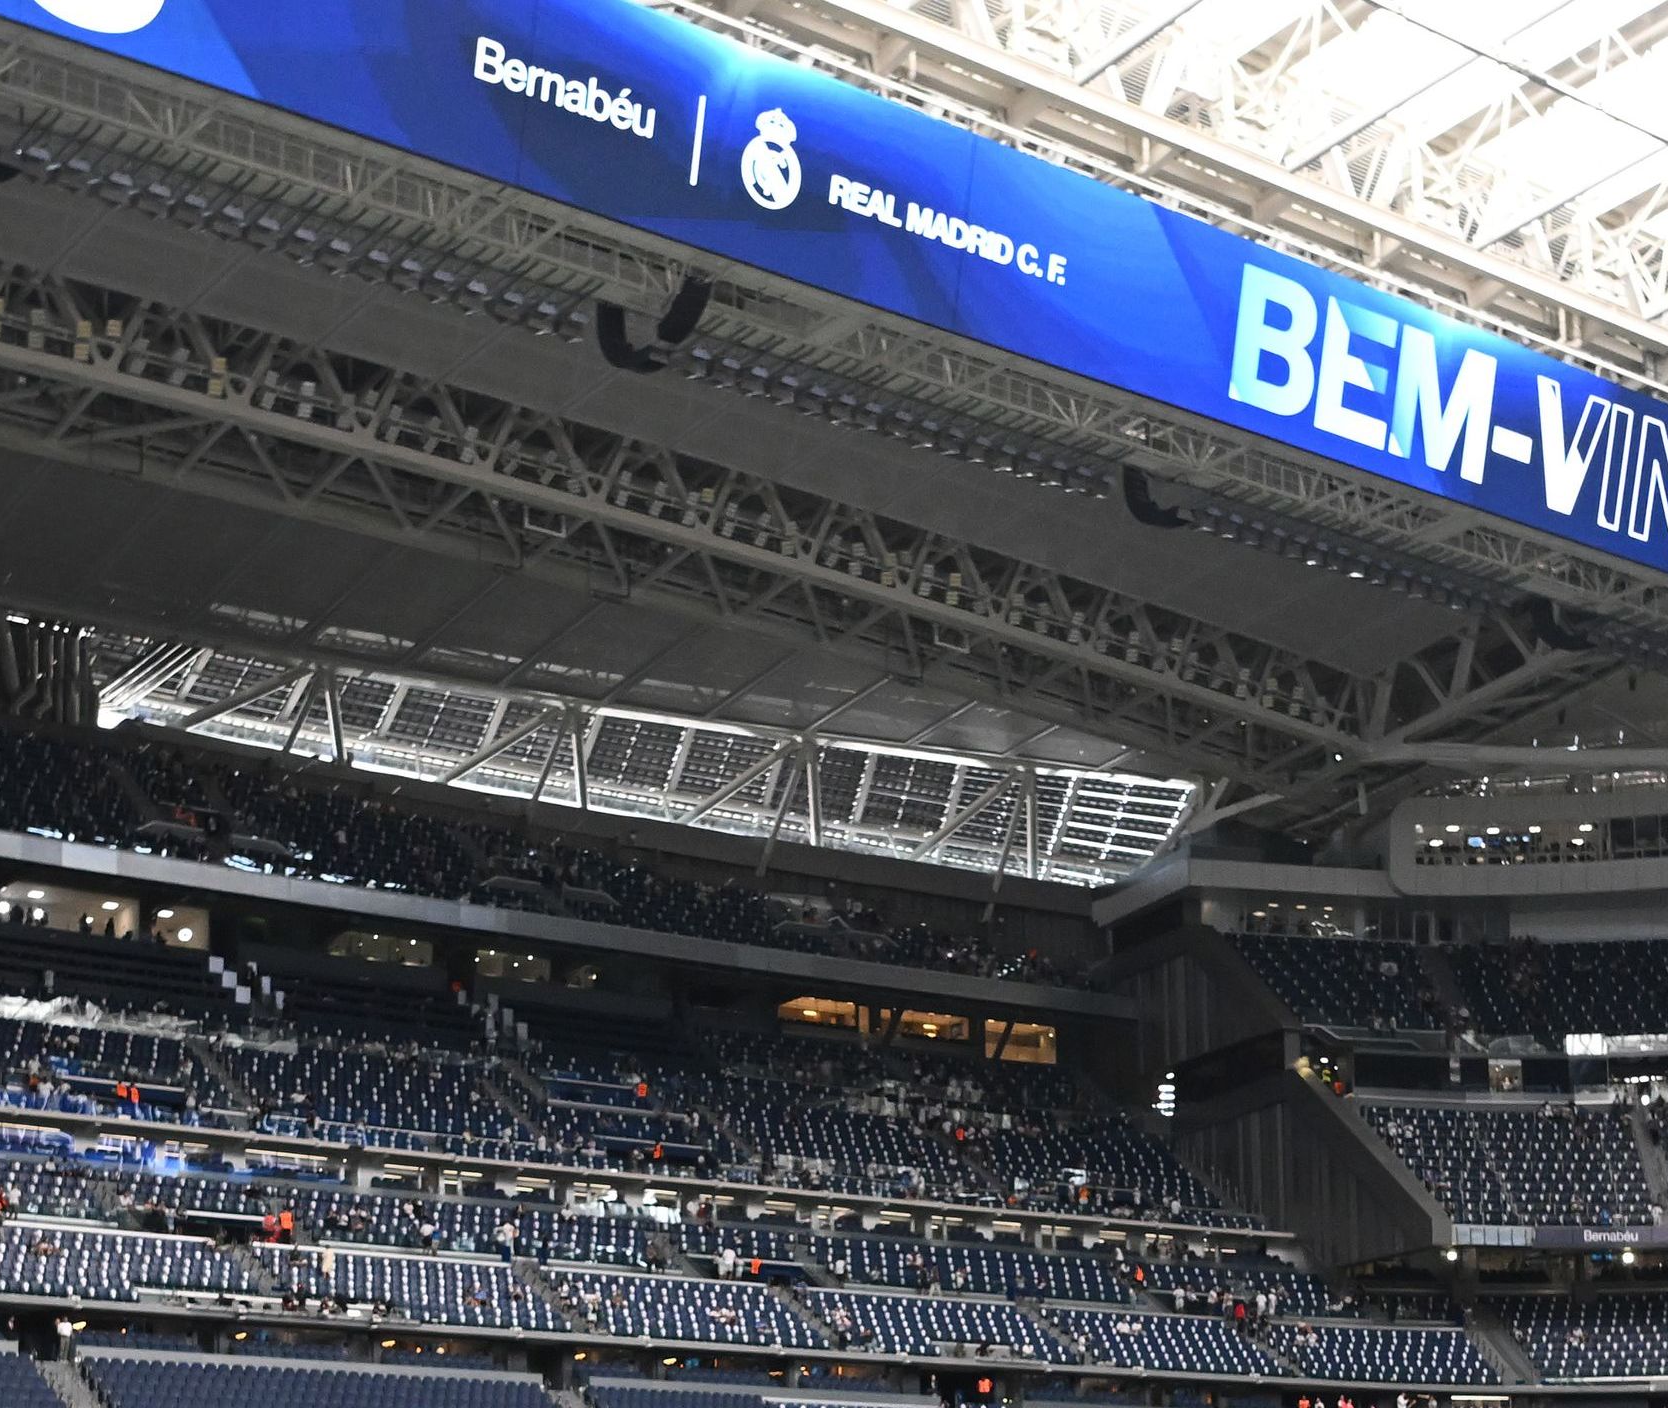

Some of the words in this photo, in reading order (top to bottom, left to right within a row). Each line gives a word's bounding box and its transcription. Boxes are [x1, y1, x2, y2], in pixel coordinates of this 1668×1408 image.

[474, 37, 656, 138] Bernabéu
[829, 175, 902, 227] REAL
[906, 203, 1013, 264] MADRID
[1017, 244, 1043, 277] C.
[1048, 254, 1067, 285] F.
[1584, 1229, 1639, 1242] Bernabéu
